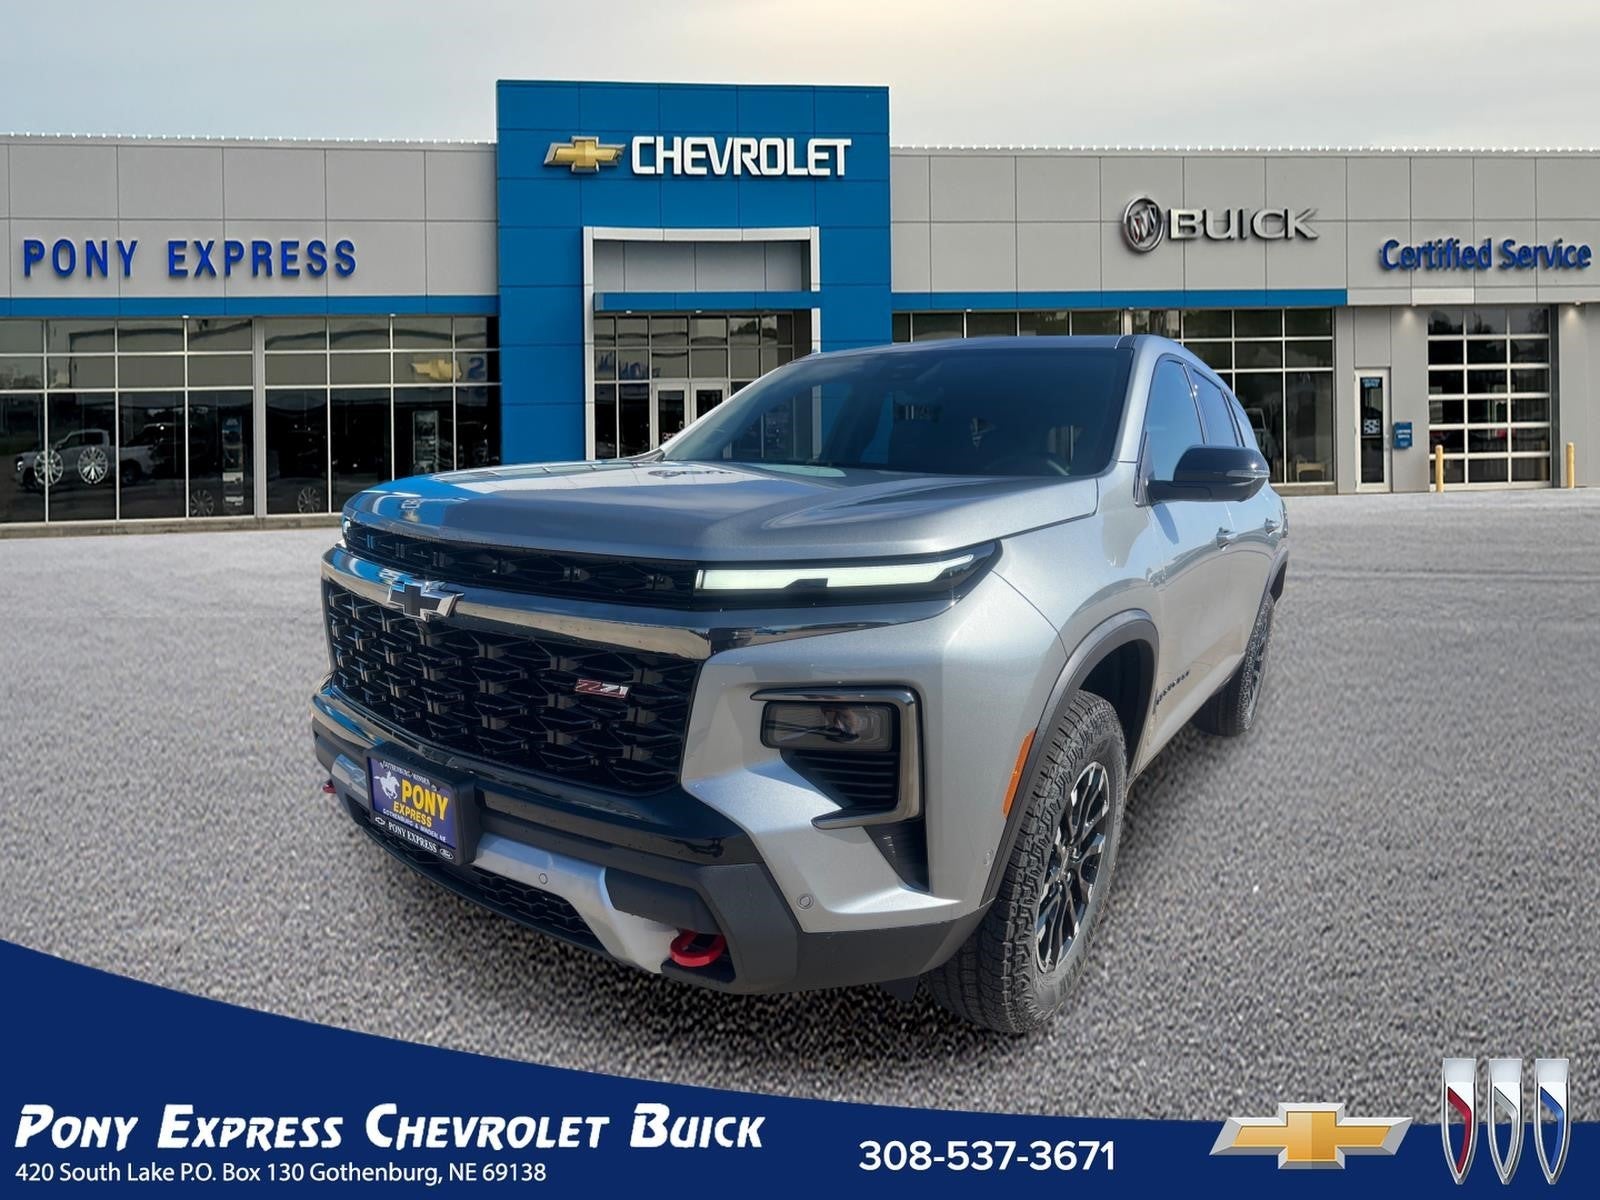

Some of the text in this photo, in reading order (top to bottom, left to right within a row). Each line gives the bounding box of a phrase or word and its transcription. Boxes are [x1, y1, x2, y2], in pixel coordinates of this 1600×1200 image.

[631, 136, 852, 176] CHEVROLET
[1169, 208, 1319, 240] BUICK
[23, 239, 357, 278] PONY EXPRESS
[1381, 238, 1592, 271] Certified Service
[575, 679, 629, 698] Z71
[393, 801, 433, 828] EXPRESS
[401, 779, 449, 820] PONY
[388, 821, 438, 853] PONY EXPRESS
